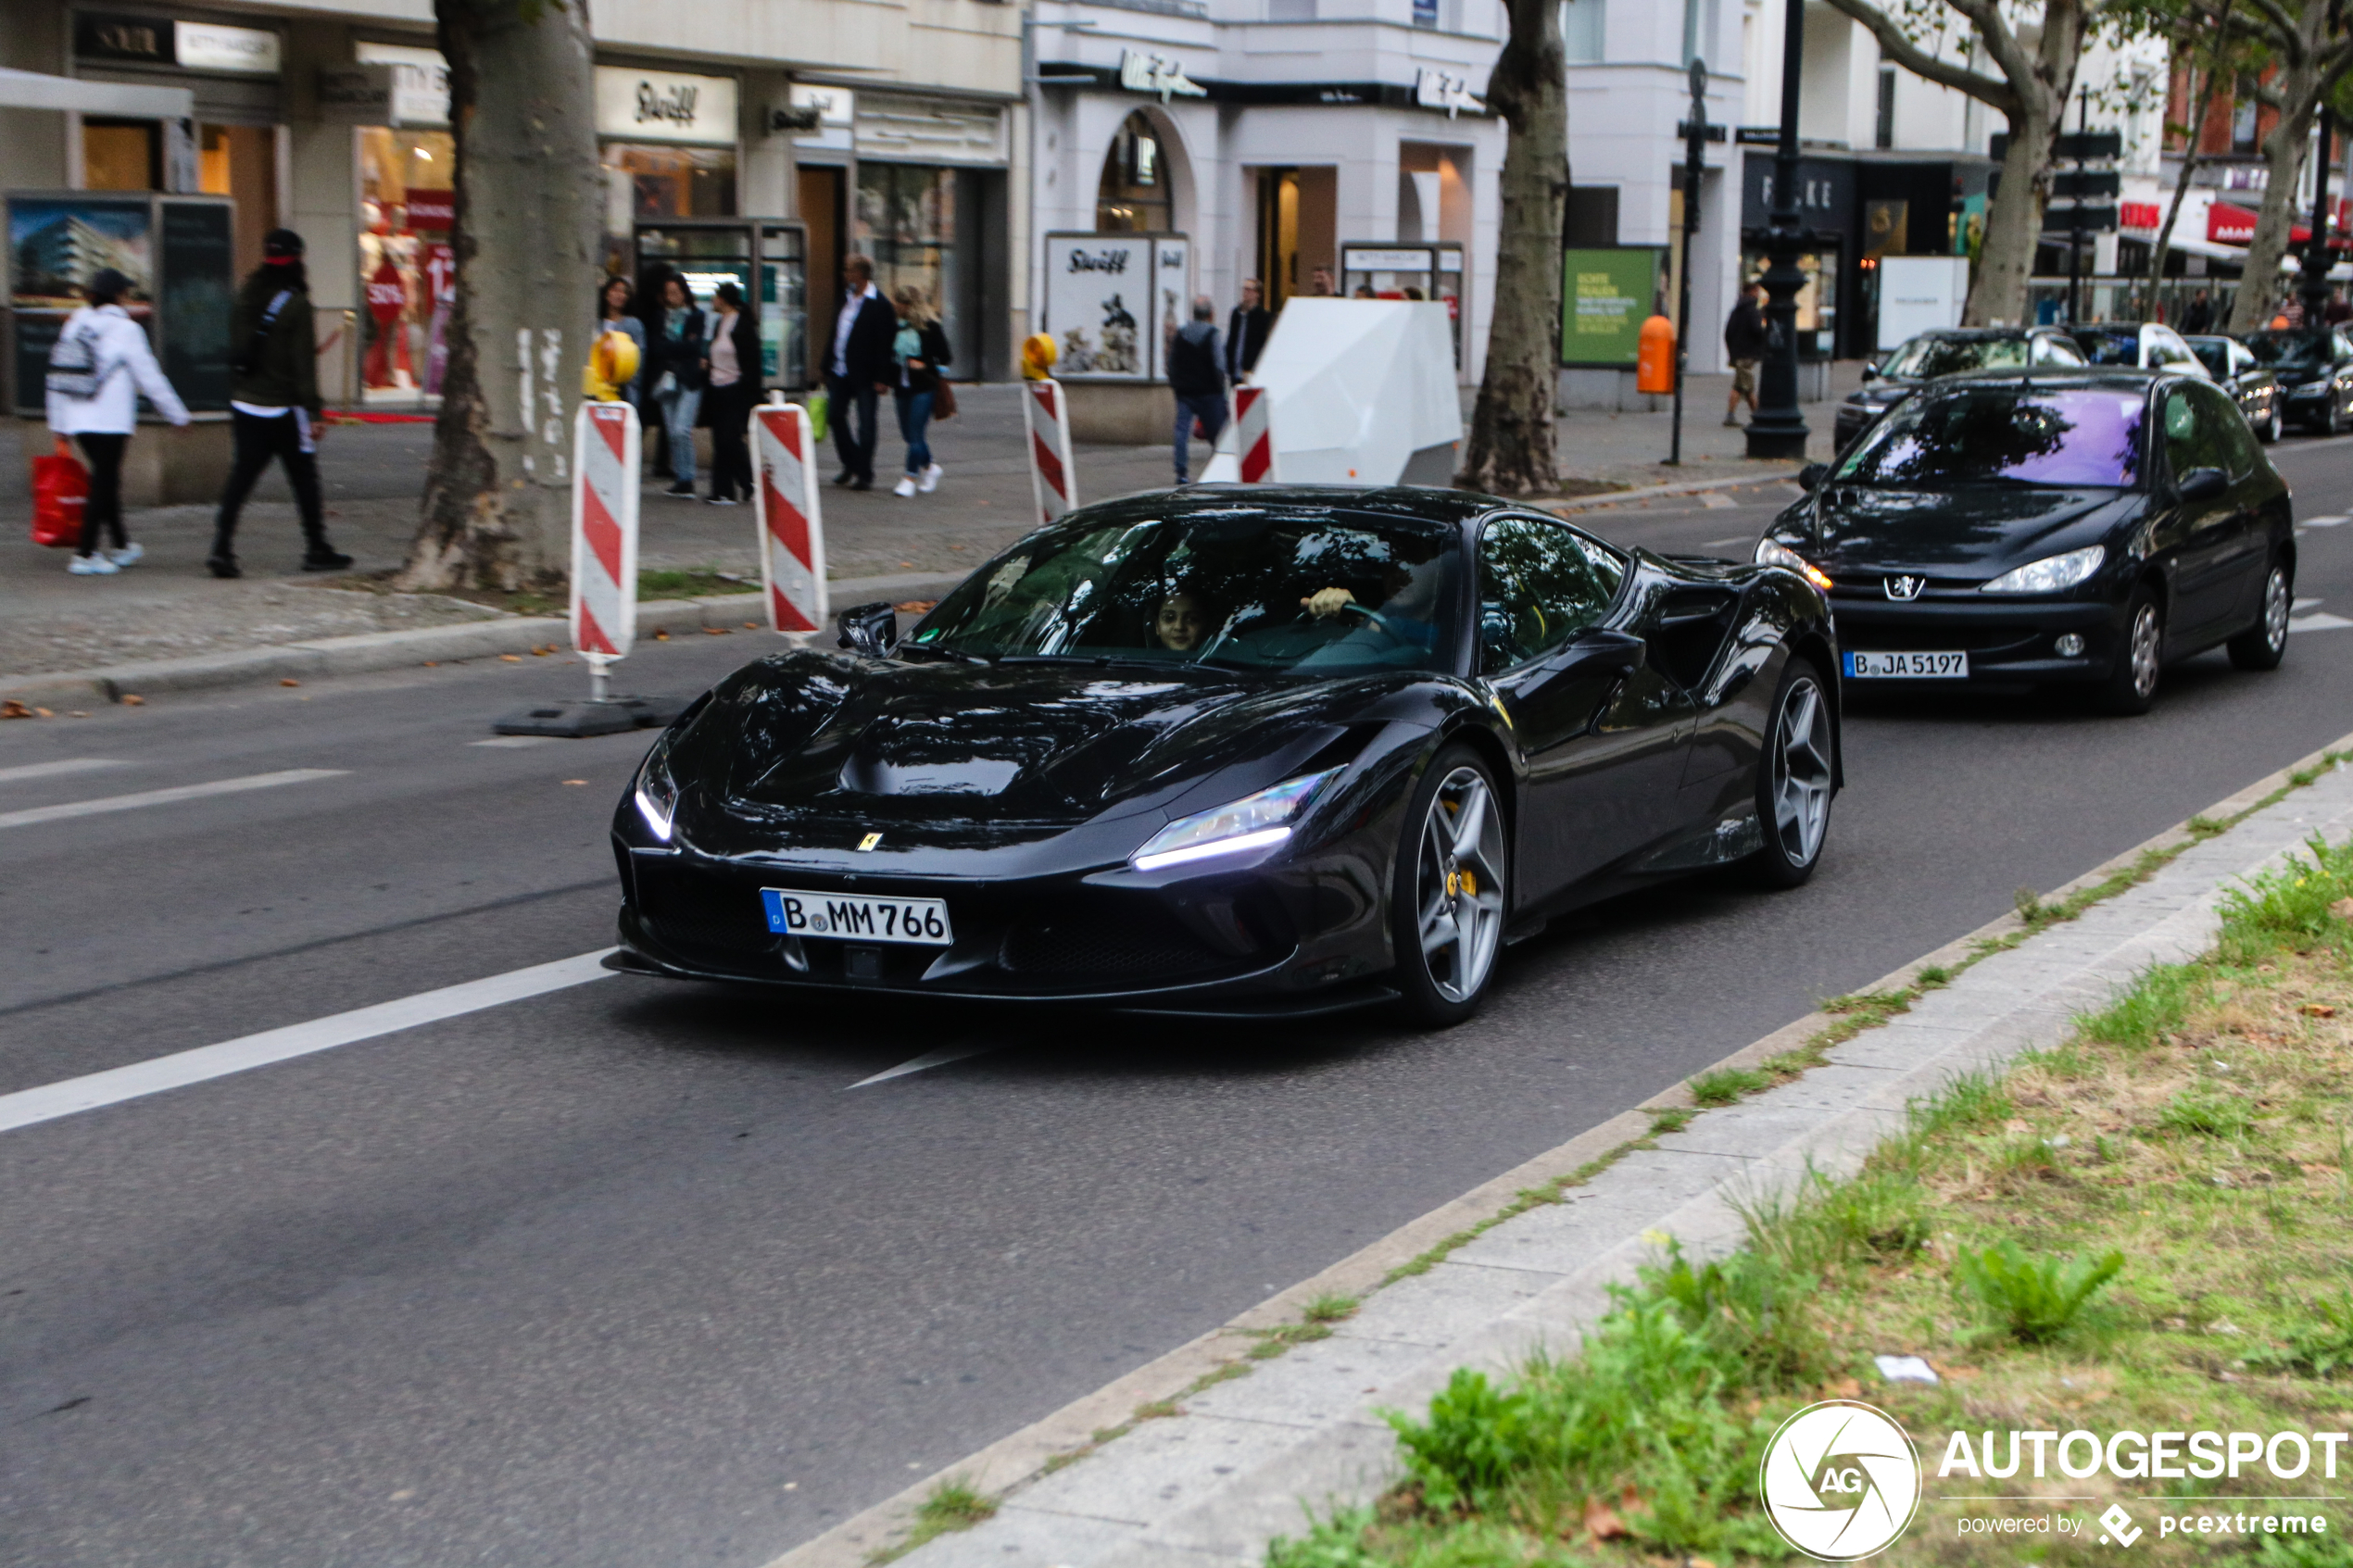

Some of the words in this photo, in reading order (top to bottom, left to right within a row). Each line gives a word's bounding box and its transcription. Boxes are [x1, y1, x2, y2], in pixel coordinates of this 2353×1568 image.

[634, 80, 699, 127] Steiff
[1067, 248, 1130, 274] Steiff
[1855, 654, 1868, 674] B
[1882, 654, 1907, 674] JA
[1912, 654, 1963, 674] 5197
[783, 897, 807, 928] B
[826, 900, 875, 935] MM
[877, 904, 944, 938] 766
